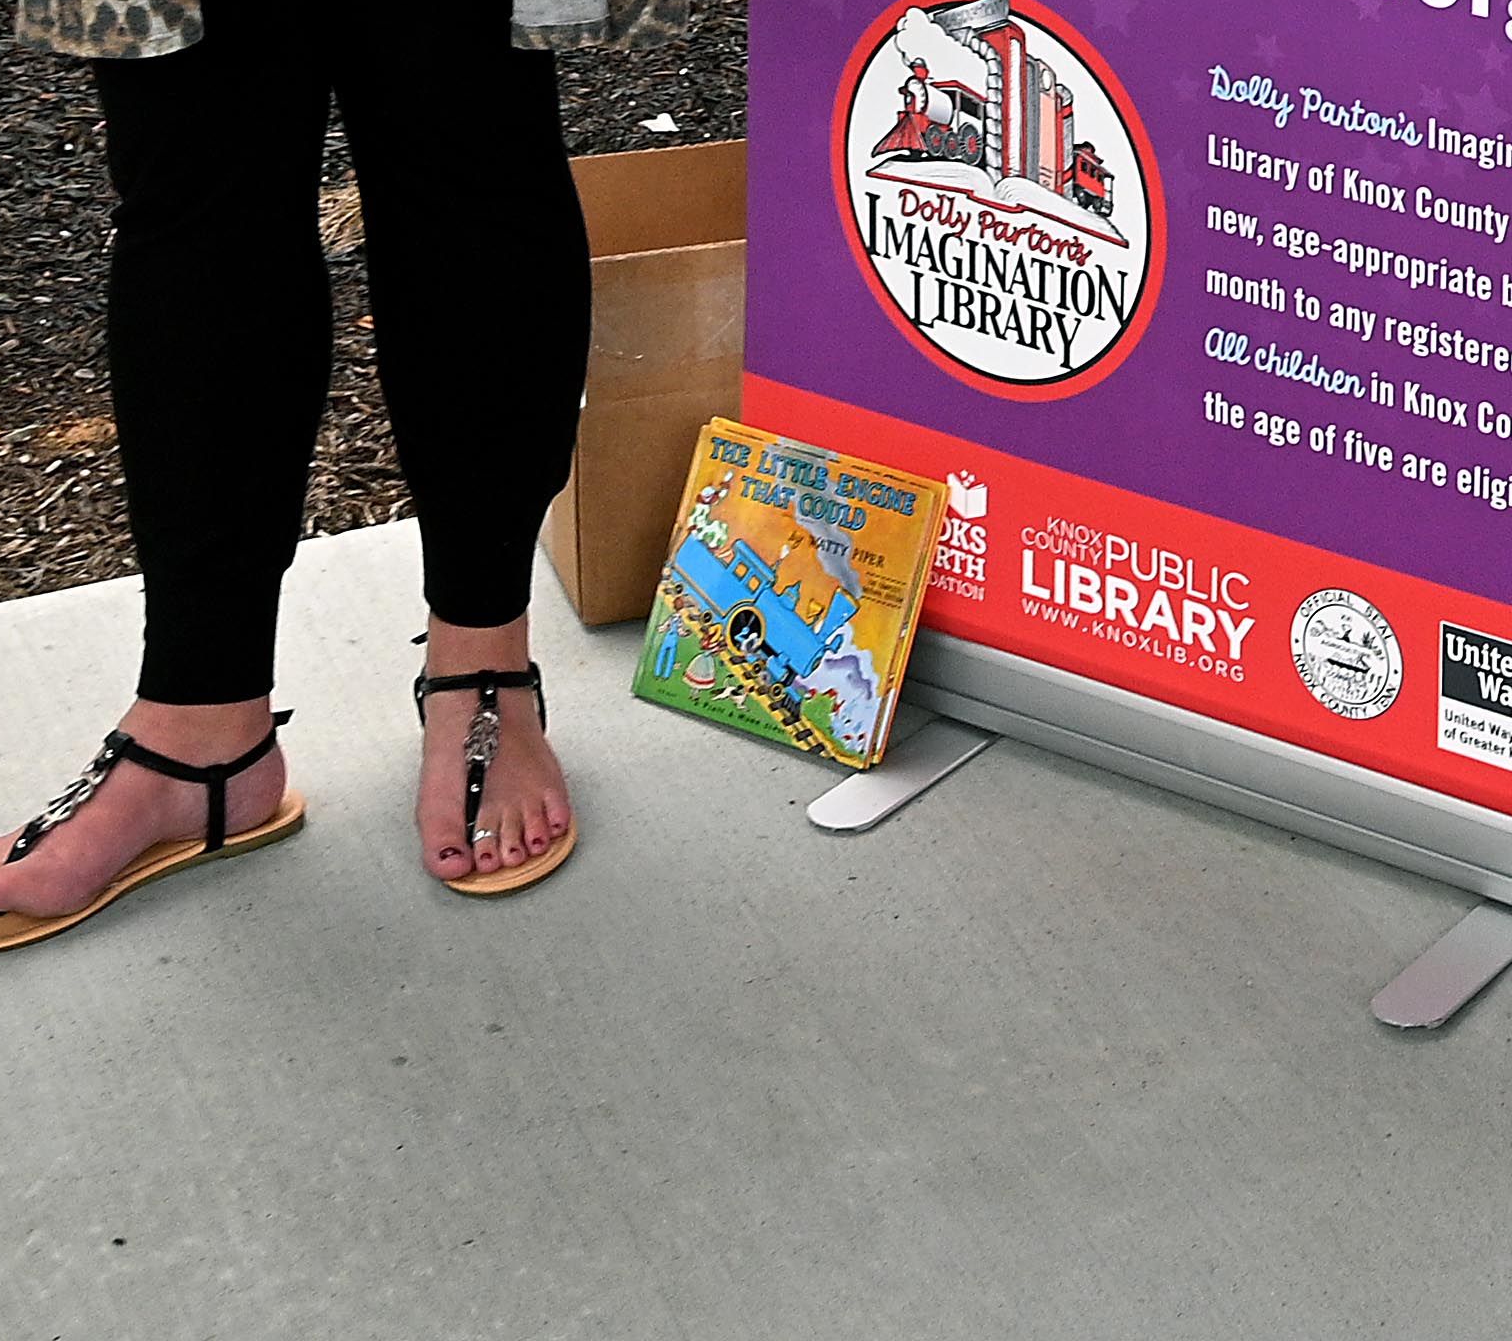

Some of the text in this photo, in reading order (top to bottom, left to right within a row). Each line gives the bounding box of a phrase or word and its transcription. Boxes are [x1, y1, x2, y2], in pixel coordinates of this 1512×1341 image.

[1208, 65, 1295, 129] Dolly
[1300, 86, 1423, 146] Parton's
[1207, 134, 1299, 191] Library
[1308, 165, 1334, 196] of
[1343, 167, 1406, 215] Knox
[1416, 186, 1508, 243] County
[865, 191, 1128, 328] IMAGINATION
[899, 188, 1093, 267] Dolly Parton's
[1207, 205, 1264, 247] new,
[1273, 221, 1492, 302] age-appropriate
[911, 270, 1083, 371] LIBRARY
[1207, 269, 1285, 313] month
[1294, 287, 1320, 321] to
[1329, 301, 1375, 342] any
[1254, 339, 1366, 398] children
[1371, 372, 1394, 407] in
[1404, 381, 1467, 428] Knox
[1204, 391, 1245, 429] the
[1254, 410, 1301, 447] age
[1310, 425, 1336, 455] of
[1344, 429, 1394, 471] five
[1402, 453, 1447, 487] are
[710, 437, 916, 516] THE LITTLE ENGINE
[741, 476, 867, 531] THAT COULD
[809, 534, 849, 556] WATTY
[853, 548, 884, 569] PIPER
[935, 545, 986, 582] RTH
[938, 516, 987, 554] OKS
[1021, 528, 1102, 566] COUNTY
[1047, 516, 1102, 546] KNOX
[929, 571, 985, 601] DATION
[1022, 549, 1256, 660] LIBRARY
[1105, 534, 1250, 610] PUBLIC
[1300, 592, 1354, 618] OFFICIAL
[1022, 598, 1244, 683] WWW.KNOXLIB.ORG
[1294, 653, 1319, 693] KNOX
[1320, 692, 1367, 717] COUNTY
[1445, 709, 1485, 732] United
[1444, 728, 1456, 740] of
[1459, 732, 1505, 757] Greater
